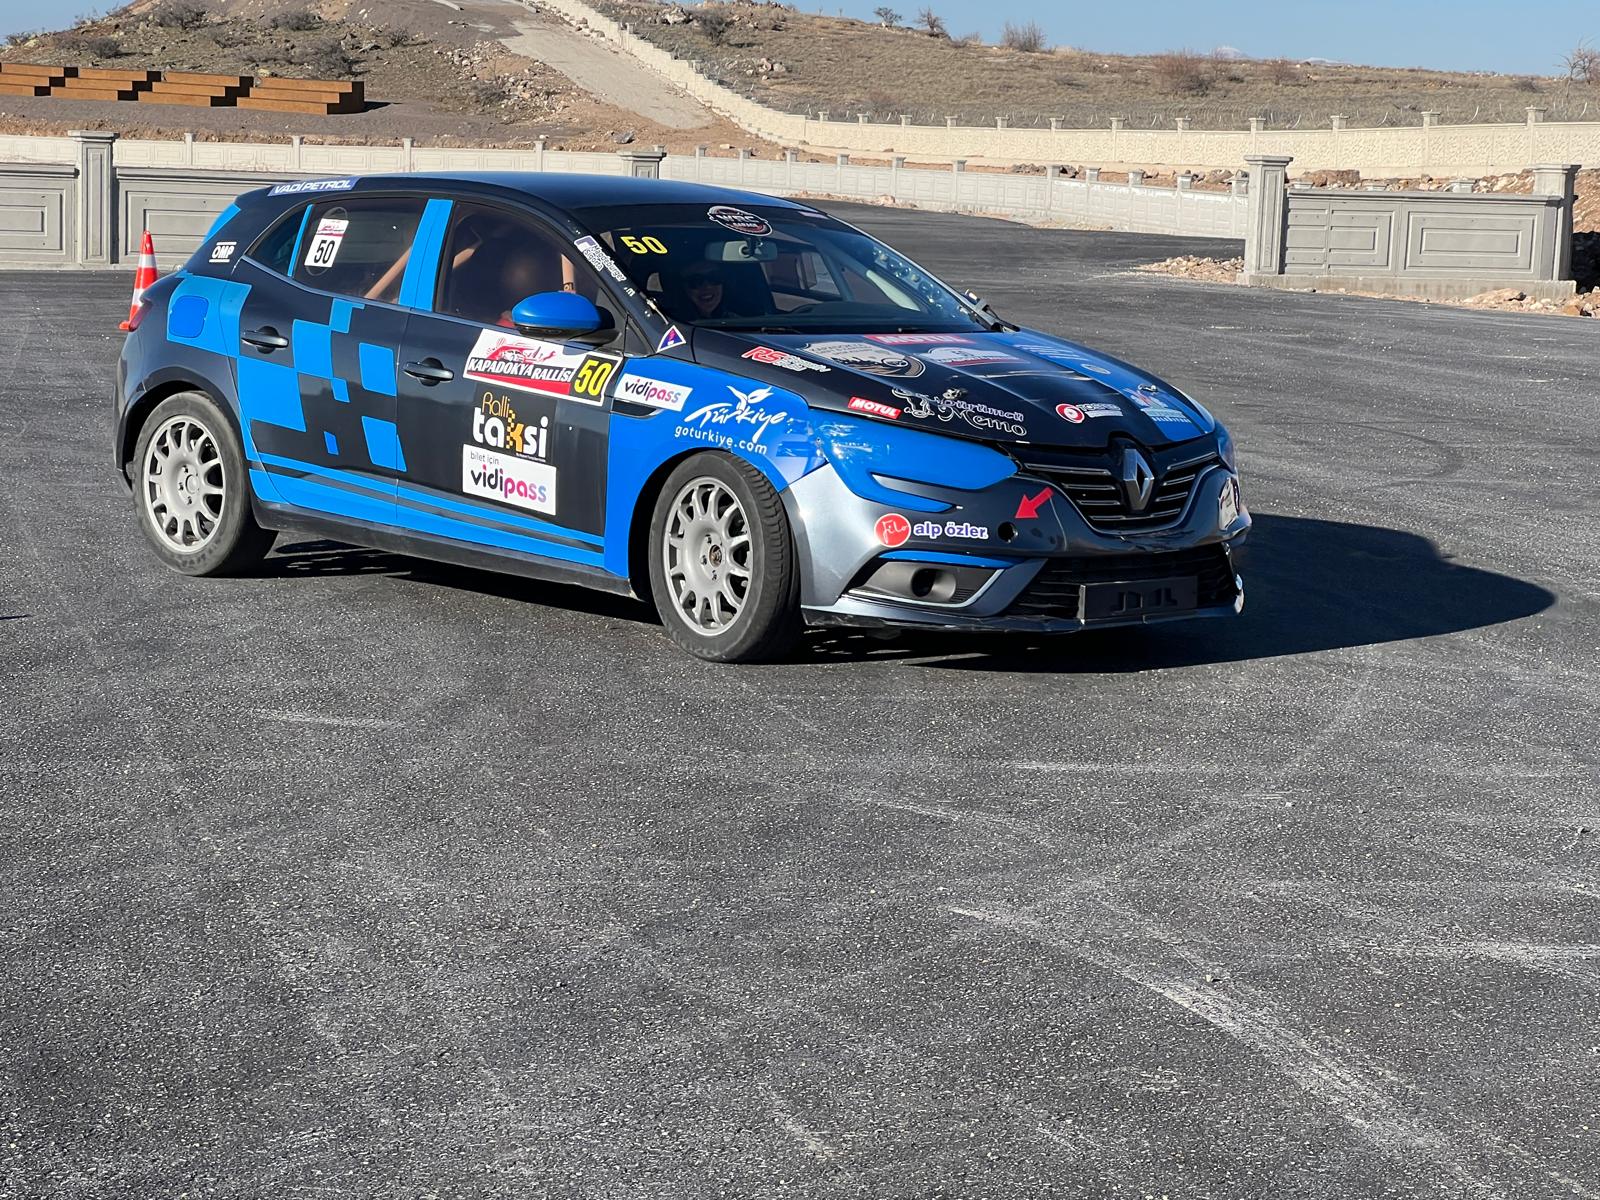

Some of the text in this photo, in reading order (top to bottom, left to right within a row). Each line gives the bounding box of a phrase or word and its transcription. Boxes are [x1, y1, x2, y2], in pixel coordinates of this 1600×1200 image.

[211, 246, 235, 259] OMP
[313, 240, 335, 264] 50
[620, 236, 668, 254] 50
[467, 358, 535, 376] KAPADOKYA
[574, 359, 612, 396] 50
[625, 379, 681, 404] vidipass
[482, 391, 511, 419] Ralli
[851, 399, 898, 417] MOTUL
[473, 407, 549, 458] taksi
[684, 402, 787, 444] Türkiye
[674, 425, 767, 455] goturkiye.com
[471, 451, 500, 465] bilet için
[470, 464, 547, 502] vidipass
[915, 523, 987, 538] alp özler
